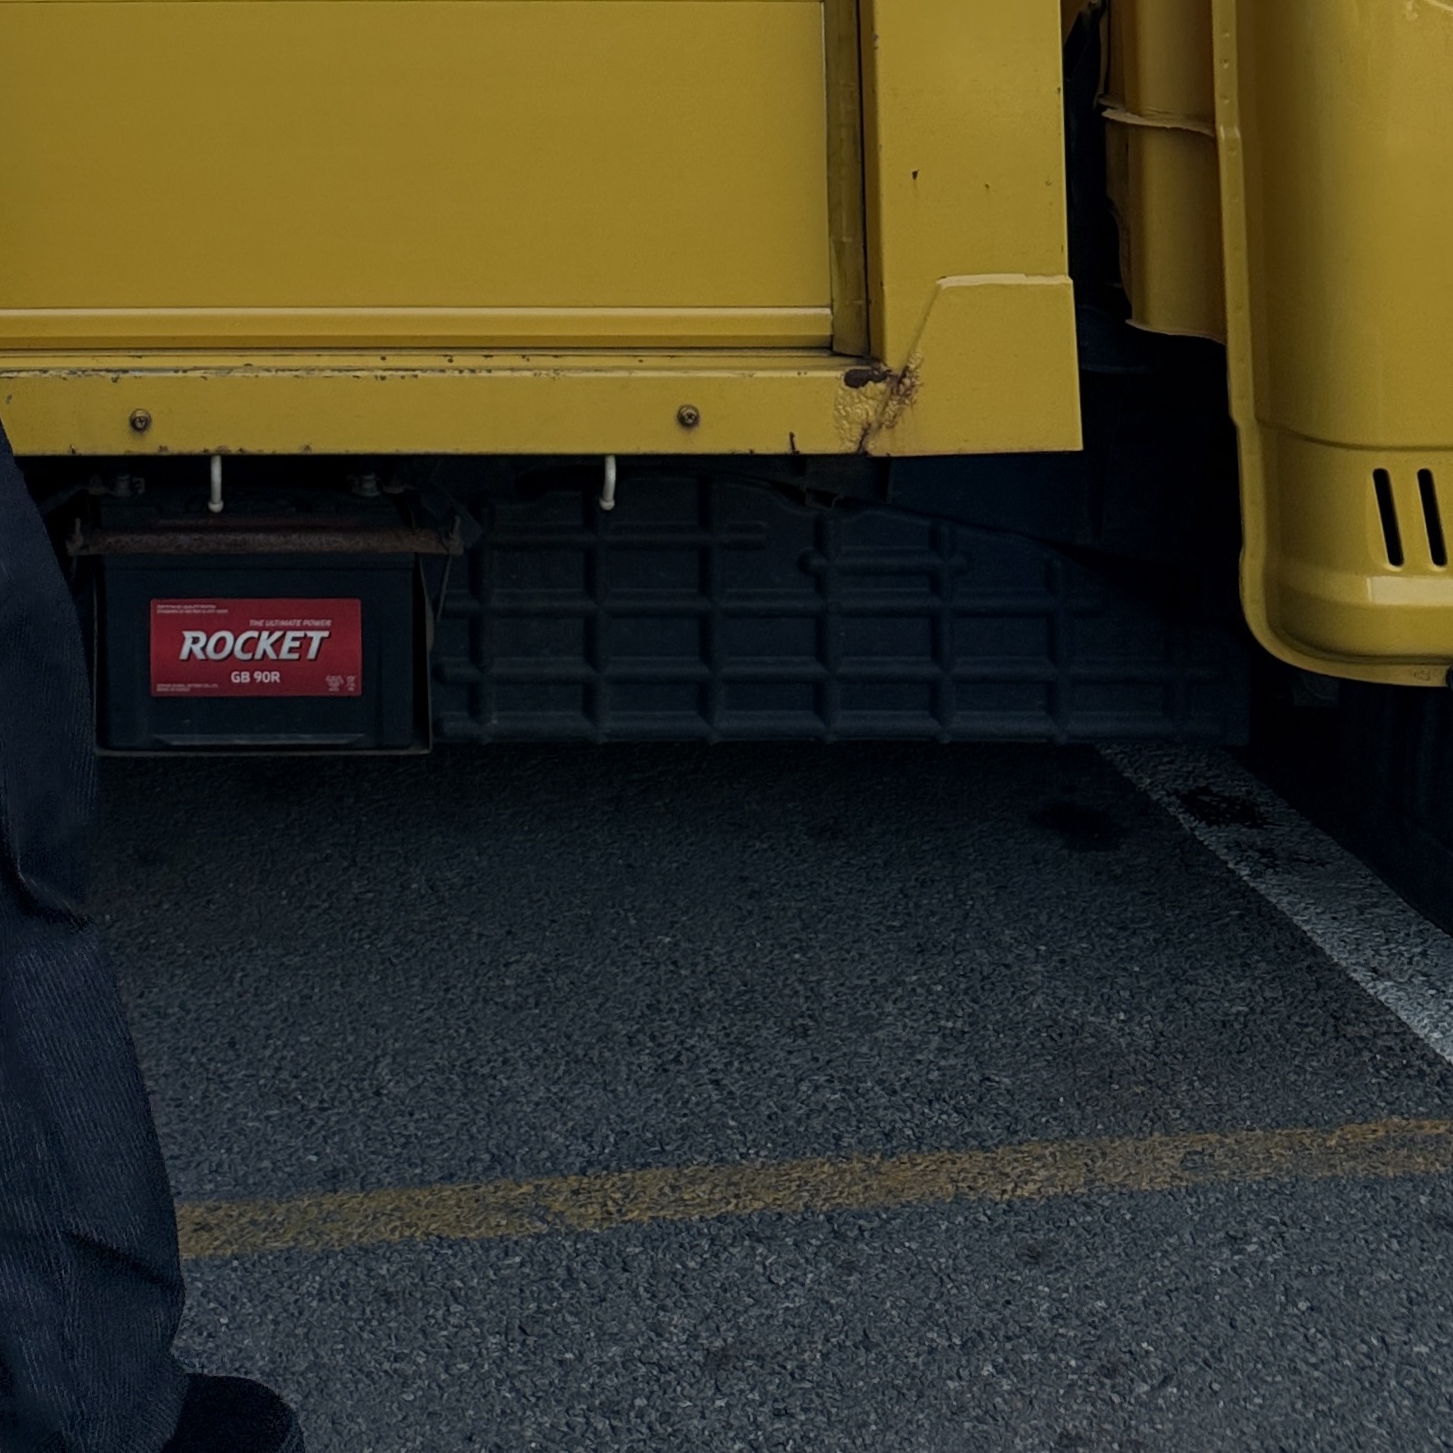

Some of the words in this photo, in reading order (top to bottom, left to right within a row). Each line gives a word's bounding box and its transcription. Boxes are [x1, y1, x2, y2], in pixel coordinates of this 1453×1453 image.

[249, 619, 264, 627] THE
[265, 619, 302, 627] ULTIMATE
[303, 619, 332, 627] POWER
[179, 630, 330, 661] ROCKET
[231, 671, 250, 683] GB
[253, 671, 280, 683] 90R
